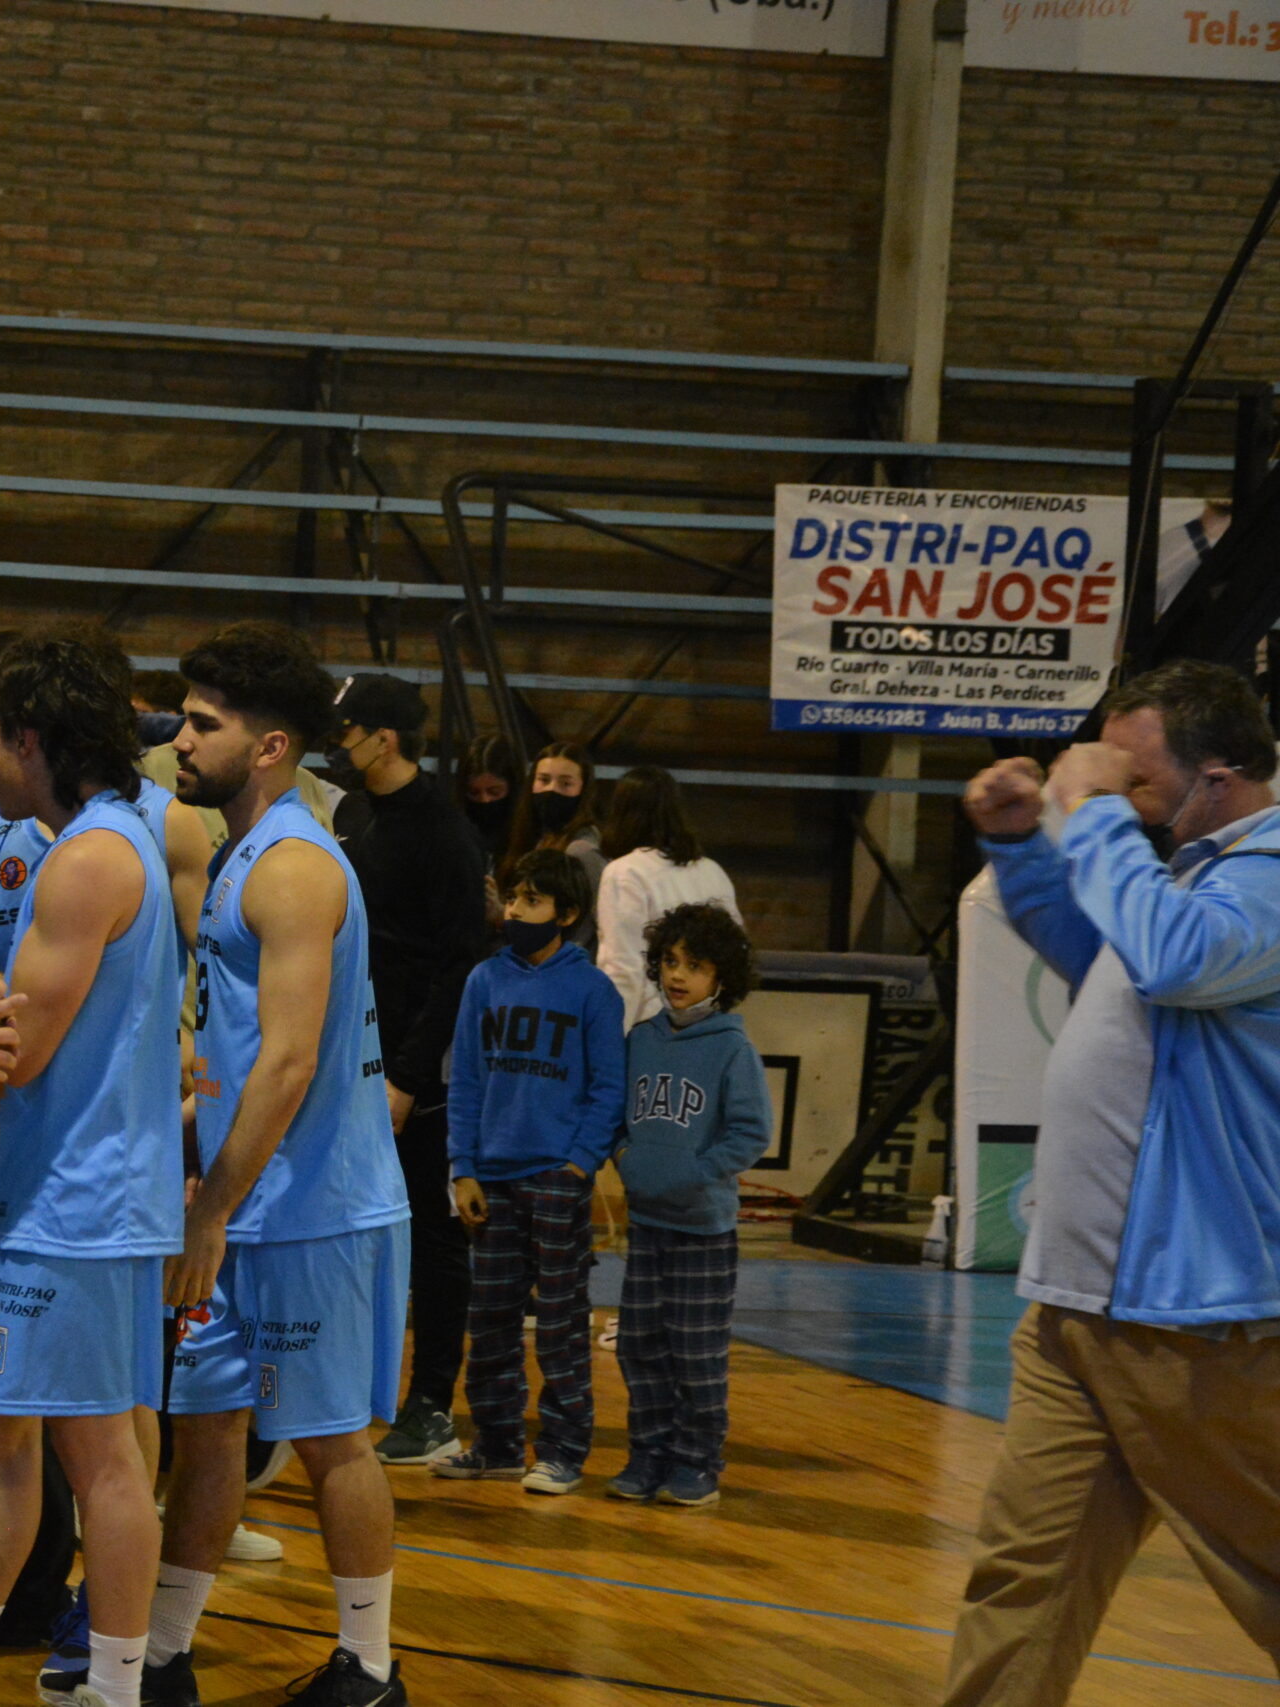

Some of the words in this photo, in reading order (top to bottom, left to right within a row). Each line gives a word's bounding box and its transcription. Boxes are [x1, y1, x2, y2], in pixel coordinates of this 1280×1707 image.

[1183, 10, 1260, 46] Tel.:
[935, 493, 946, 507] Y
[950, 493, 1087, 513] ENCOMIENDAS
[790, 518, 1092, 571] DISTRI-PAQ
[812, 566, 945, 619] SAN
[957, 562, 1116, 624] JOSÉ
[844, 627, 934, 650] TODOS
[938, 630, 987, 652] LOS
[991, 628, 1056, 655] DÍAS
[797, 656, 825, 672] Río
[831, 658, 889, 674] Cuarto
[908, 660, 944, 676] Villa
[949, 662, 998, 678] María
[1015, 665, 1100, 681] Carnerillo
[876, 681, 939, 697] Deheza
[955, 684, 985, 699] Las
[990, 685, 1065, 701] Perdices
[939, 712, 982, 728] Juan
[986, 713, 1003, 729] B.
[1007, 714, 1056, 731] Justo
[481, 1006, 579, 1058] NOT
[484, 1056, 568, 1082] TMORROW
[631, 1072, 707, 1128] GAP
